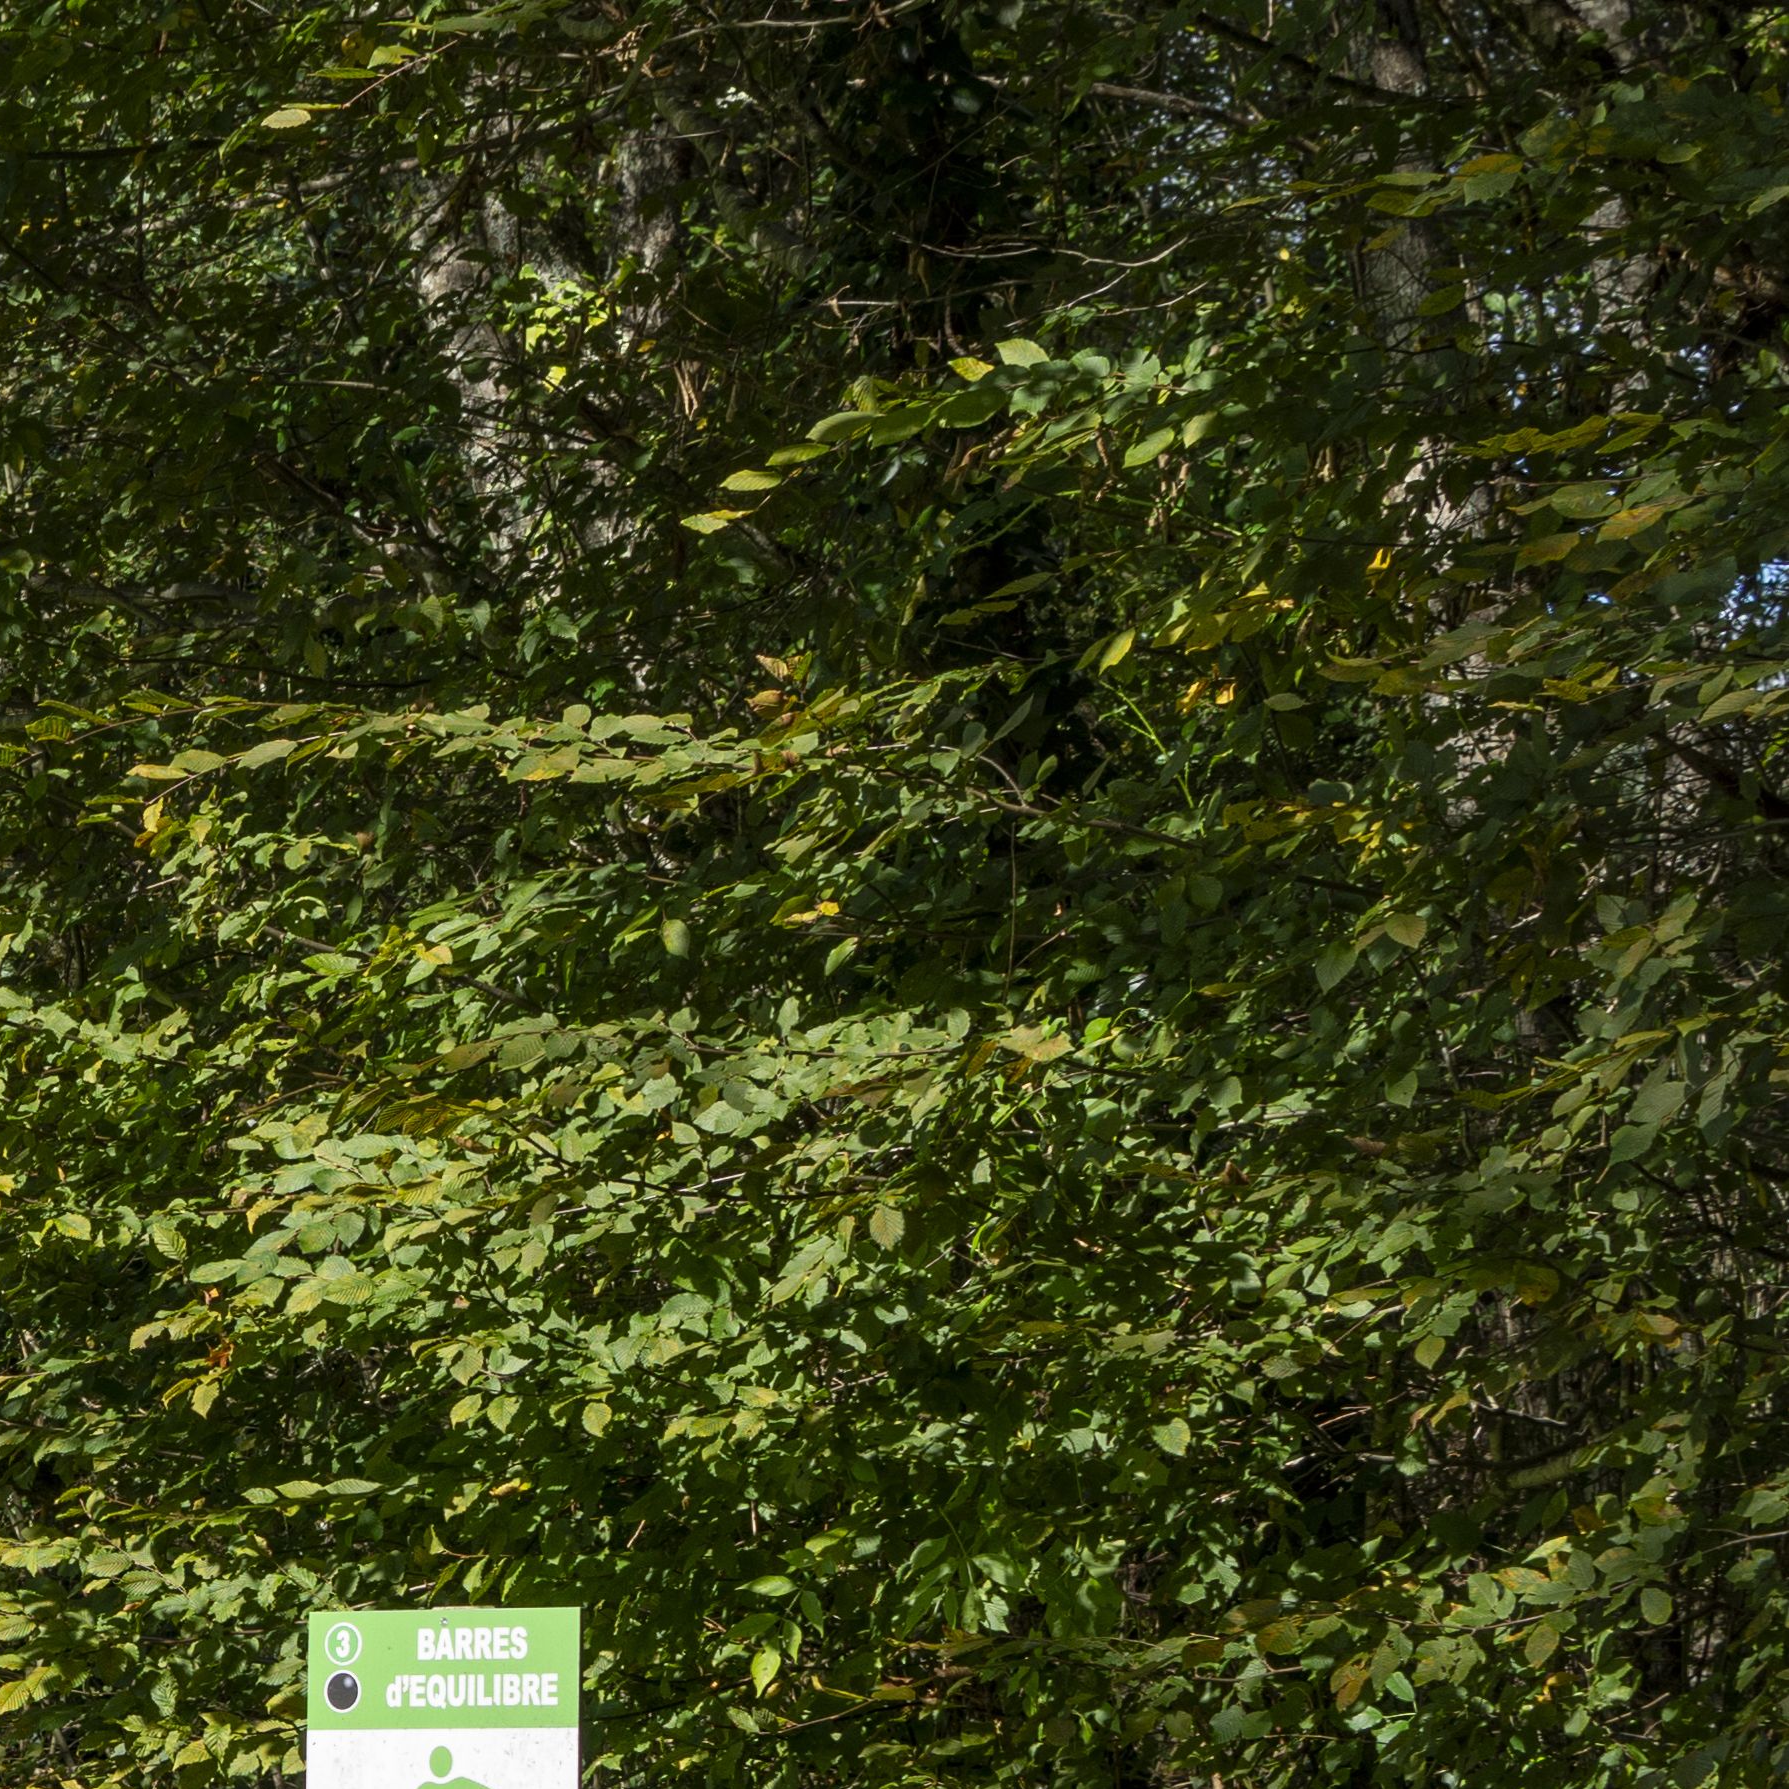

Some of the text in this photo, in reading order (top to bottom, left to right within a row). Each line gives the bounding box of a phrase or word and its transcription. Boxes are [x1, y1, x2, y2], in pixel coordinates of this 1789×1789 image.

[336, 1629, 351, 1658] 3
[417, 1626, 528, 1661] BARRES
[385, 1672, 559, 1709] d'EQUILIBRE
